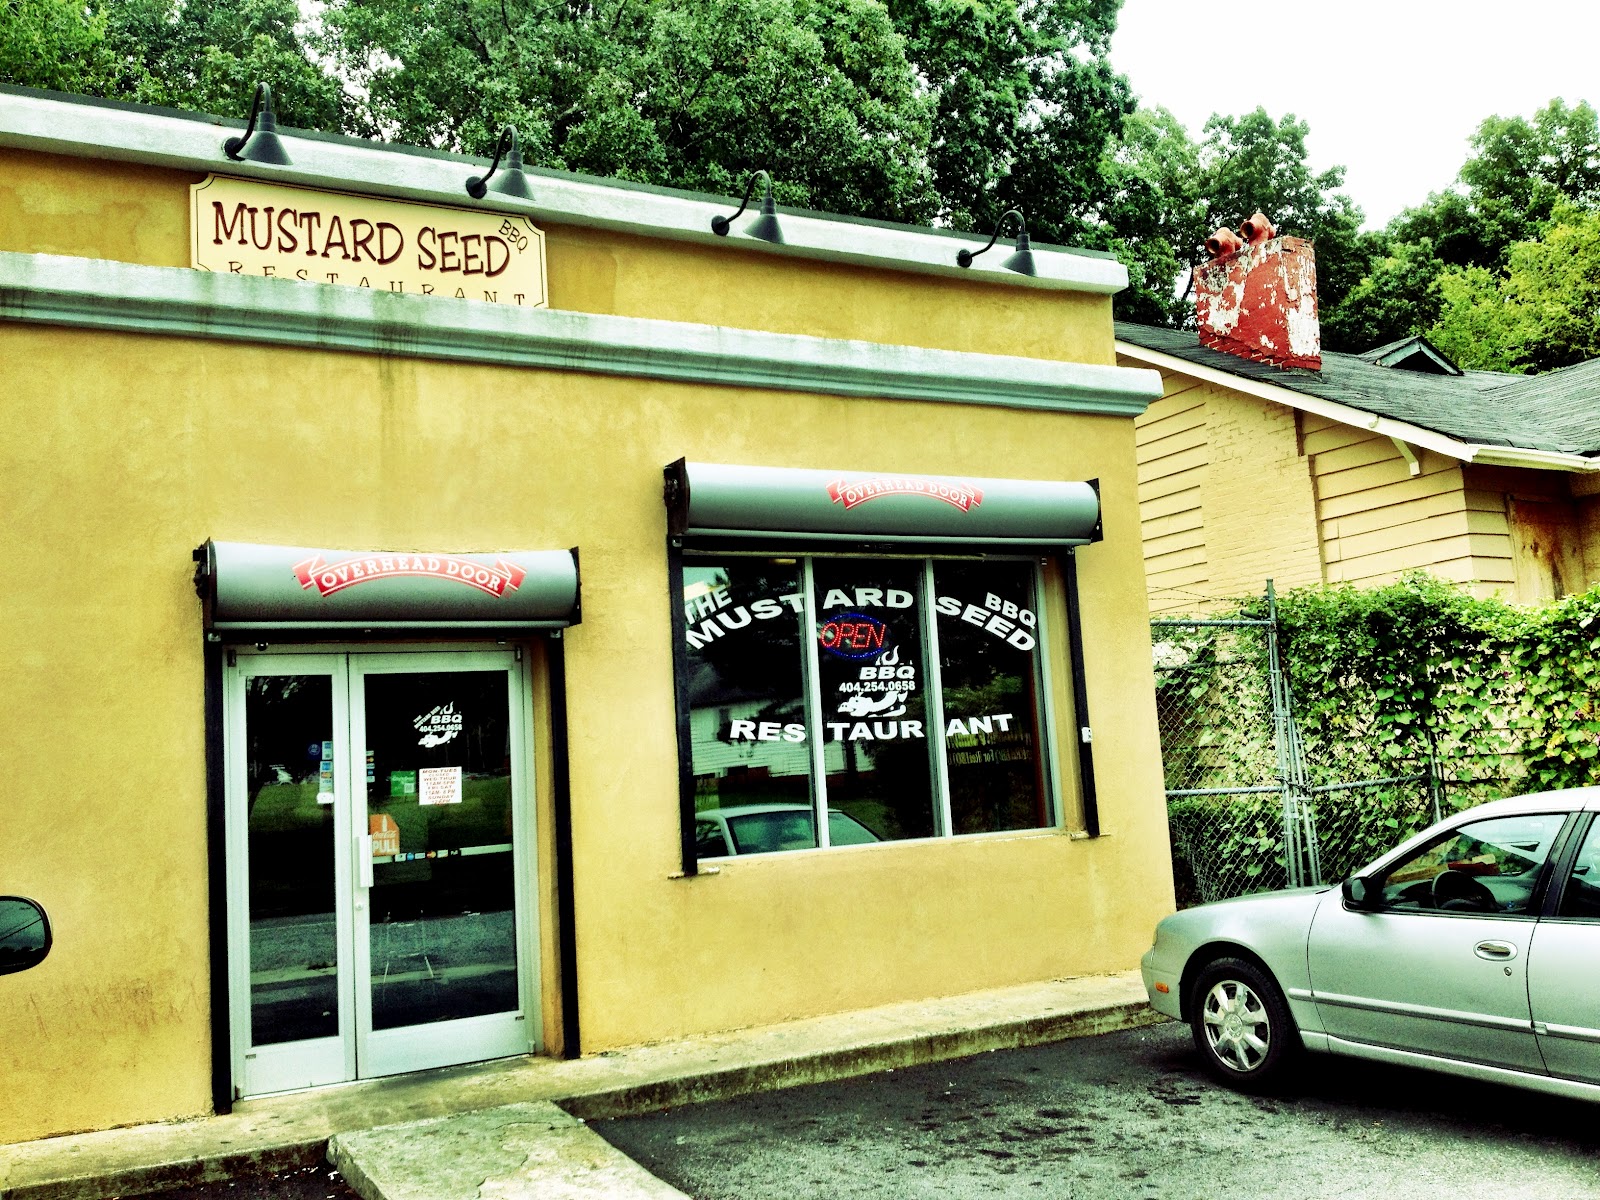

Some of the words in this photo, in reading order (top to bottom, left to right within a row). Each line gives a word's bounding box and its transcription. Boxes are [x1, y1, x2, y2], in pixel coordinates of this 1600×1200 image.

[212, 201, 404, 265] MUSTARD
[417, 226, 510, 278] SEED
[498, 218, 528, 254] BBQ
[845, 479, 924, 503] OVERHEAD
[929, 484, 968, 508] DOOR
[321, 556, 441, 588] OVERHEAD
[446, 562, 502, 592] DOOR
[685, 584, 733, 625] THE
[984, 592, 1037, 629] BBQ
[820, 622, 886, 648] OPEN
[935, 596, 1036, 651] SEED
[838, 680, 916, 693] 404.254.0658
[859, 666, 916, 680] BBQ
[430, 714, 463, 725] BBQ
[373, 839, 398, 854] PULL
